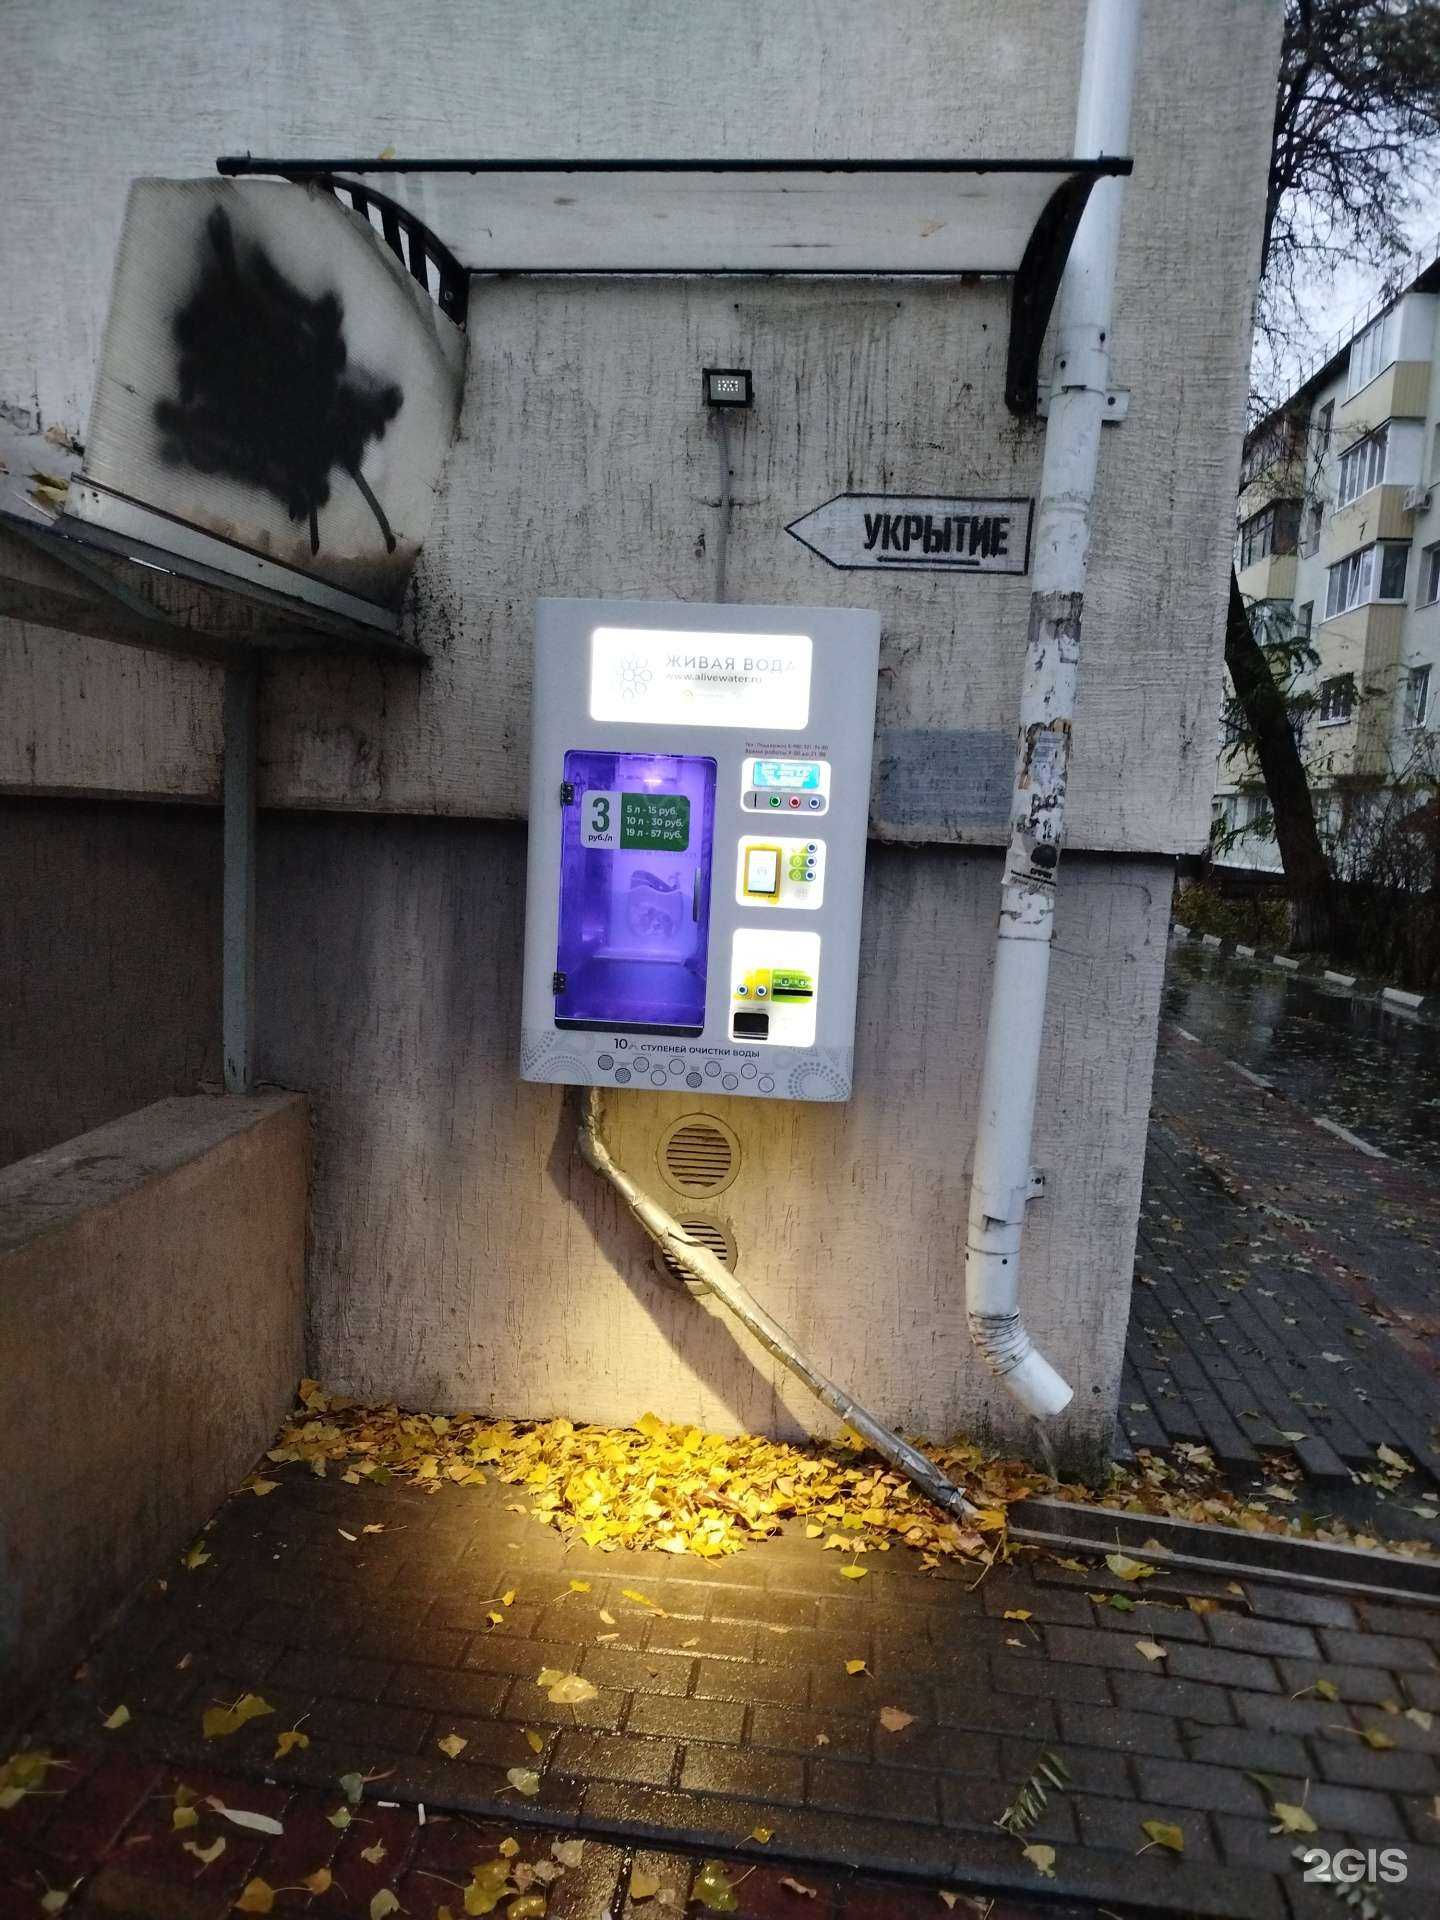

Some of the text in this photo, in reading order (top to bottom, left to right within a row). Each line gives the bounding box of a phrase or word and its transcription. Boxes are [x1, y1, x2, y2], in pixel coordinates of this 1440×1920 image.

[864, 513, 1010, 558] УКРЫТИЕ
[666, 656, 735, 670] ЖИВАЯ
[666, 672, 762, 684] www.alivewater.ru
[592, 797, 610, 833] 3
[626, 805, 633, 814] 5
[634, 805, 641, 814] л
[648, 806, 657, 814] 15
[658, 807, 678, 817] руб.
[626, 816, 636, 825] 10
[637, 817, 644, 826] л
[651, 817, 663, 826] 30
[664, 818, 684, 828] руб.
[588, 833, 613, 842] руб./л
[626, 828, 636, 837] 19
[636, 829, 643, 837] л
[651, 829, 661, 838] 57
[663, 830, 682, 840] руб.
[614, 1038, 760, 1058] 10 СТУПЕНЕЙ ОЧИСТКИ ВОДЫ
